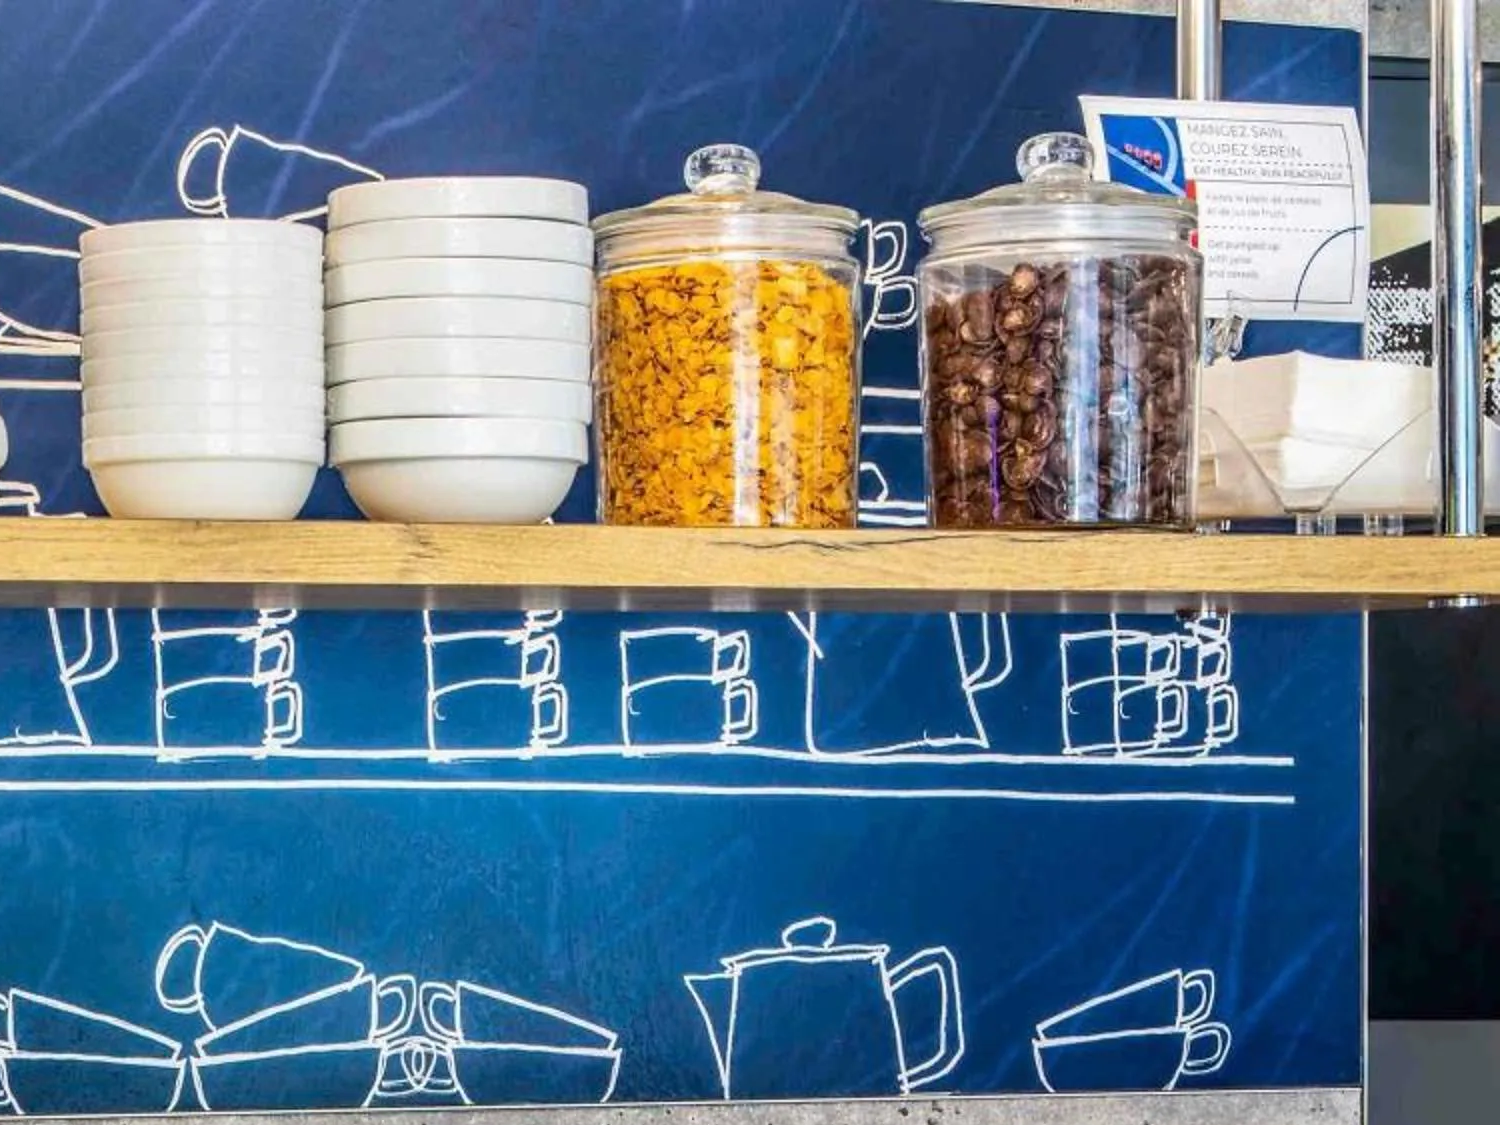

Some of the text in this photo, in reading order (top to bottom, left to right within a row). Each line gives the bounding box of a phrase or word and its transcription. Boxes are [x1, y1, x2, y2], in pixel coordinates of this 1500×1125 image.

[1187, 123, 1248, 138] MANGEZ
[1190, 141, 1303, 159] COUREZ SEREIN
